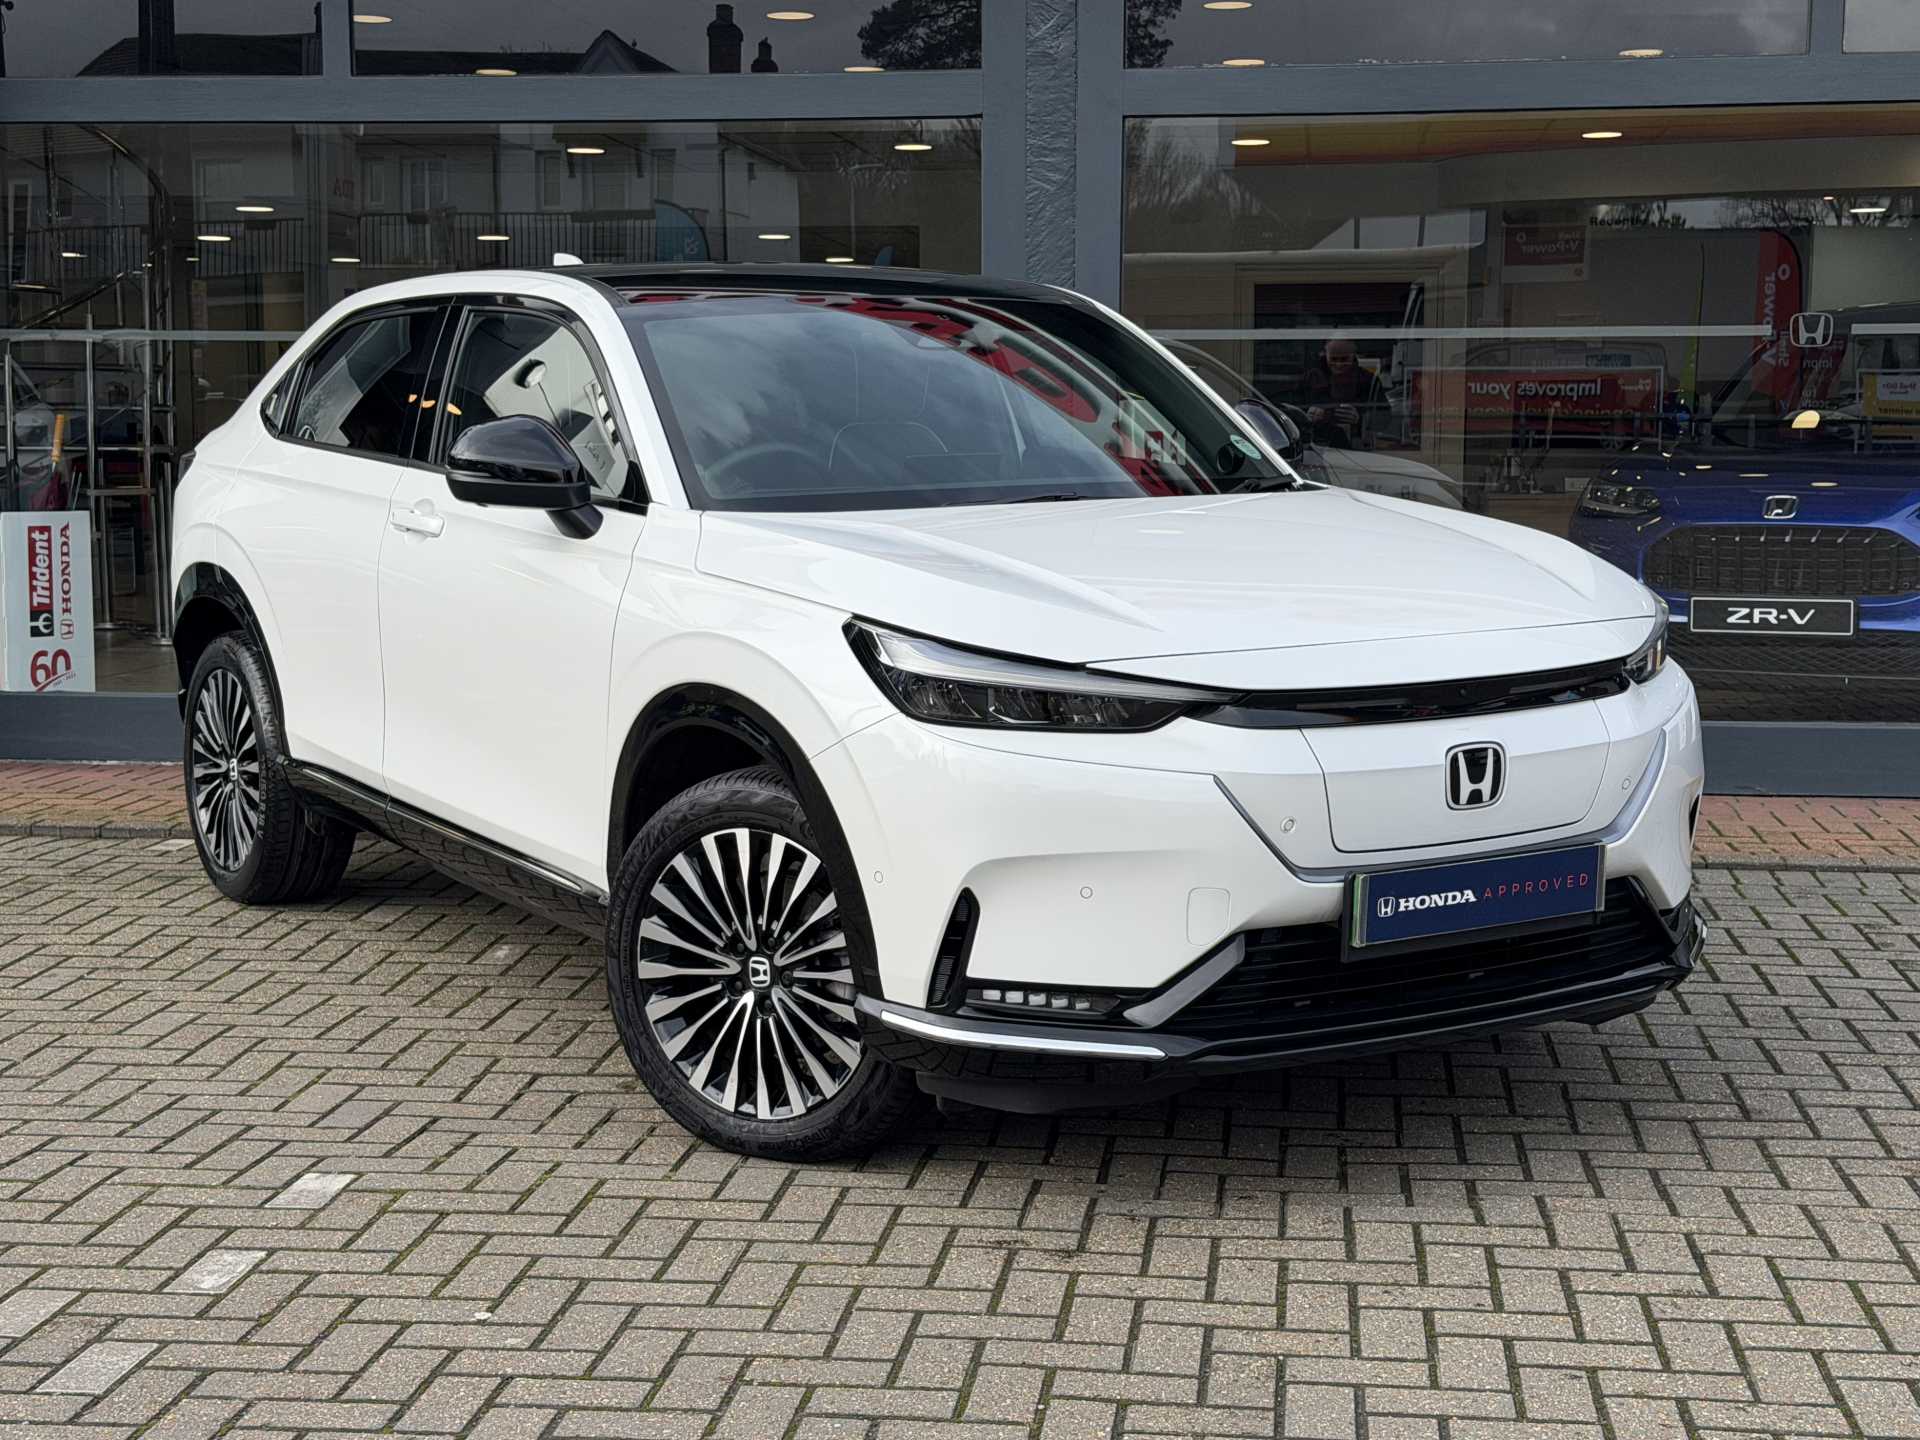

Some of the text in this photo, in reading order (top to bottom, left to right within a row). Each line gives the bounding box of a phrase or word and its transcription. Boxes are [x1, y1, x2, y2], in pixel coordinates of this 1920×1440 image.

[31, 529, 50, 608] Trident
[60, 521, 72, 616] HONDA
[1726, 607, 1816, 625] ZR-V
[30, 648, 72, 690] 60
[1398, 873, 1589, 912] HONDA APPROVED
